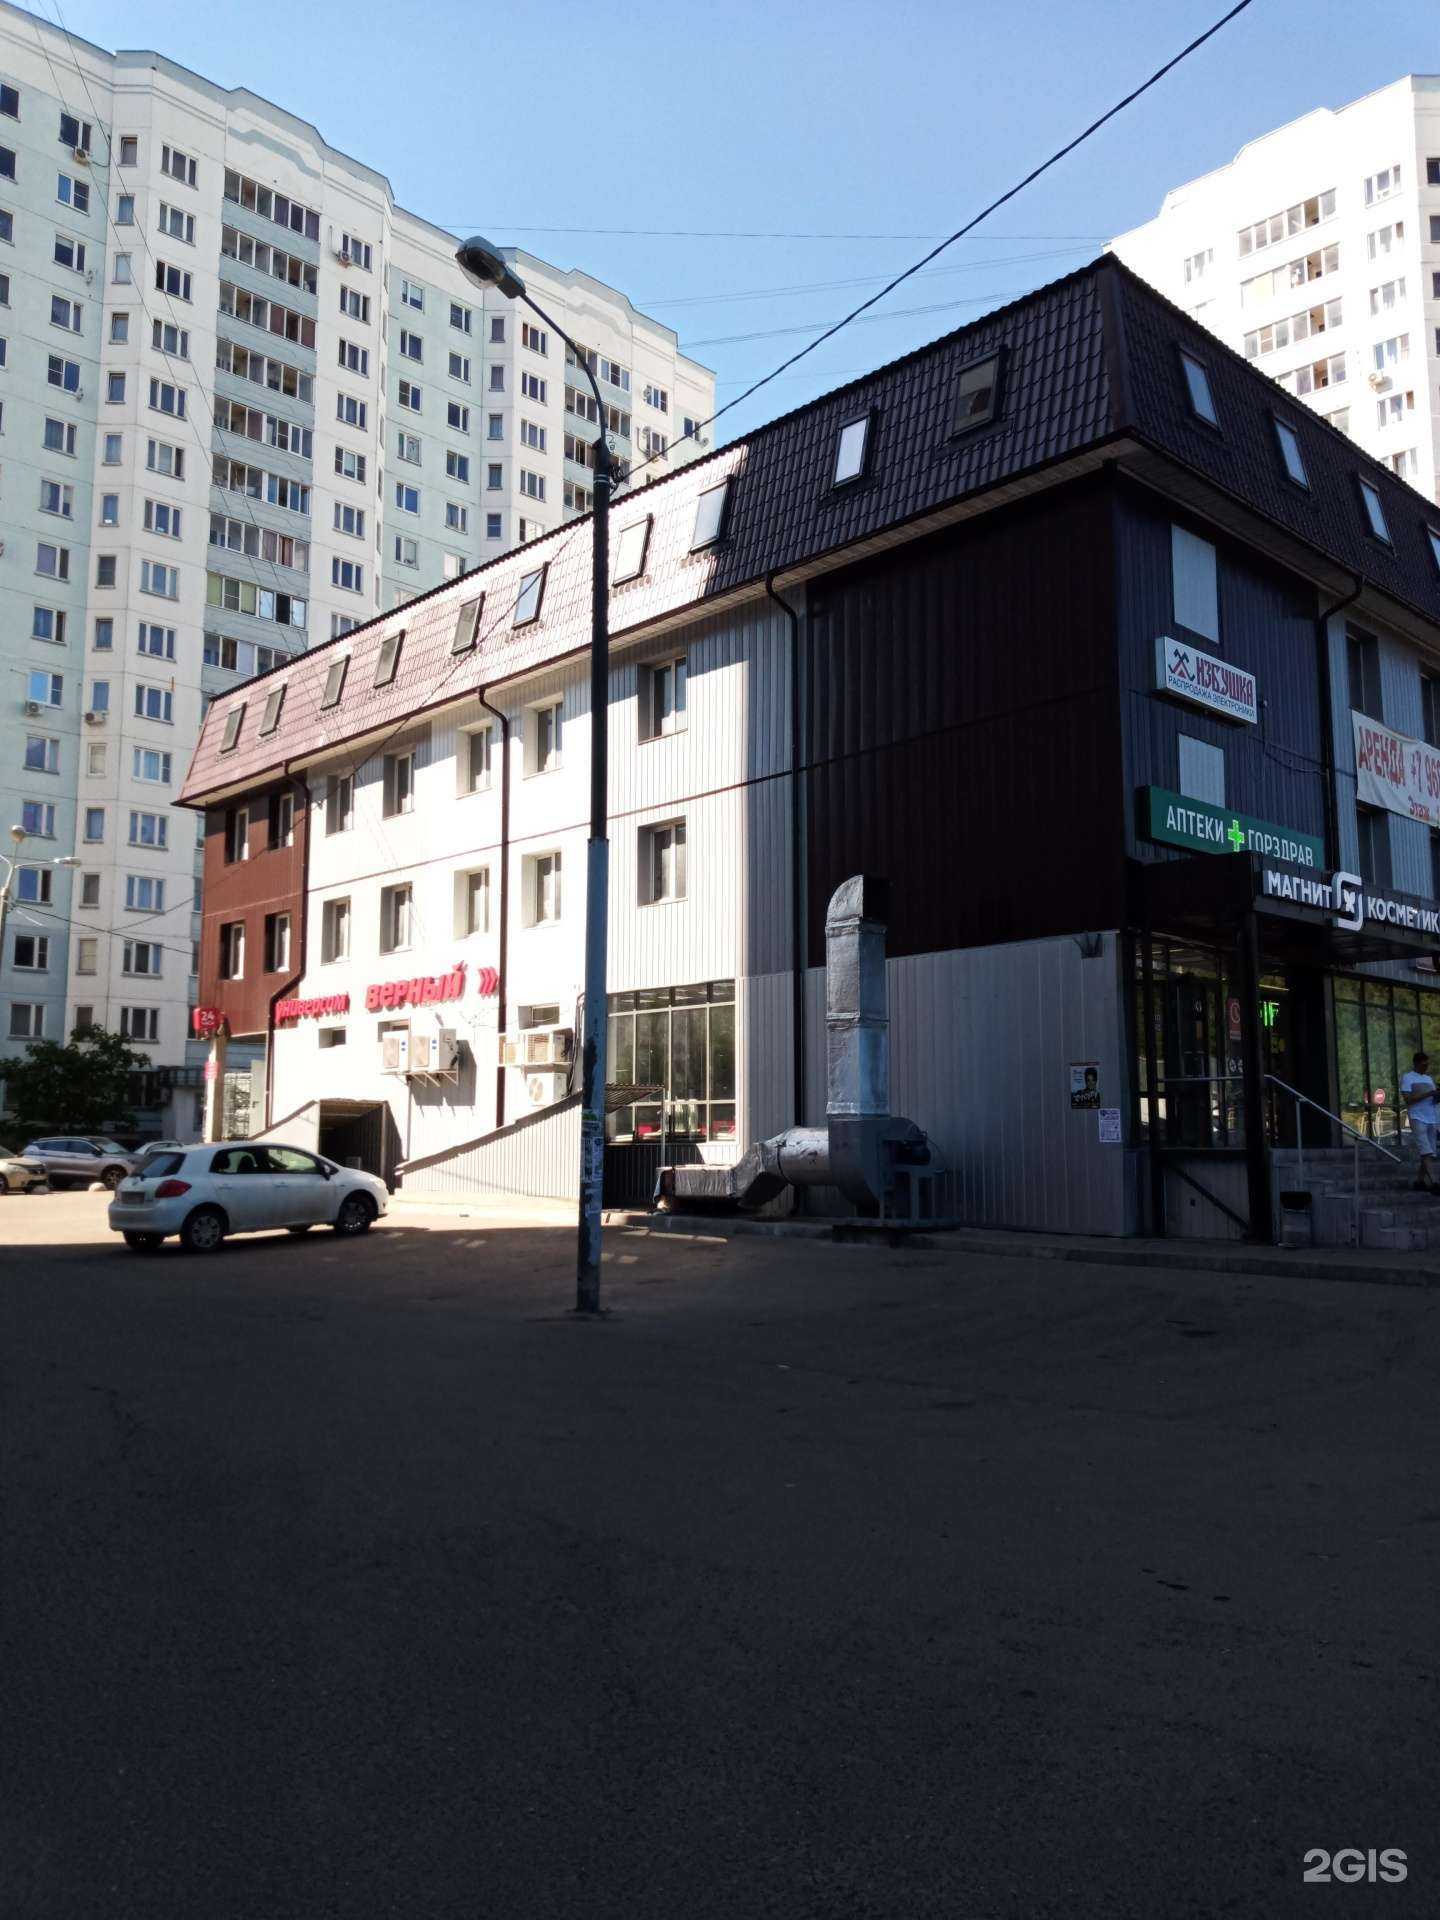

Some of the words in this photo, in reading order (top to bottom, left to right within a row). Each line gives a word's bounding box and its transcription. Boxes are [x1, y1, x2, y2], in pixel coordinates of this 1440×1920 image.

[1168, 675, 1213, 700] РАСПРОДАЖА
[1195, 656, 1254, 708] ИЗБУШКА
[1358, 726, 1406, 790] АРЕНДА
[1166, 805, 1225, 844] АПТЕКИ
[1248, 829, 1314, 867] ГОРЗДРАВ
[1267, 870, 1333, 909] МАГНИТ
